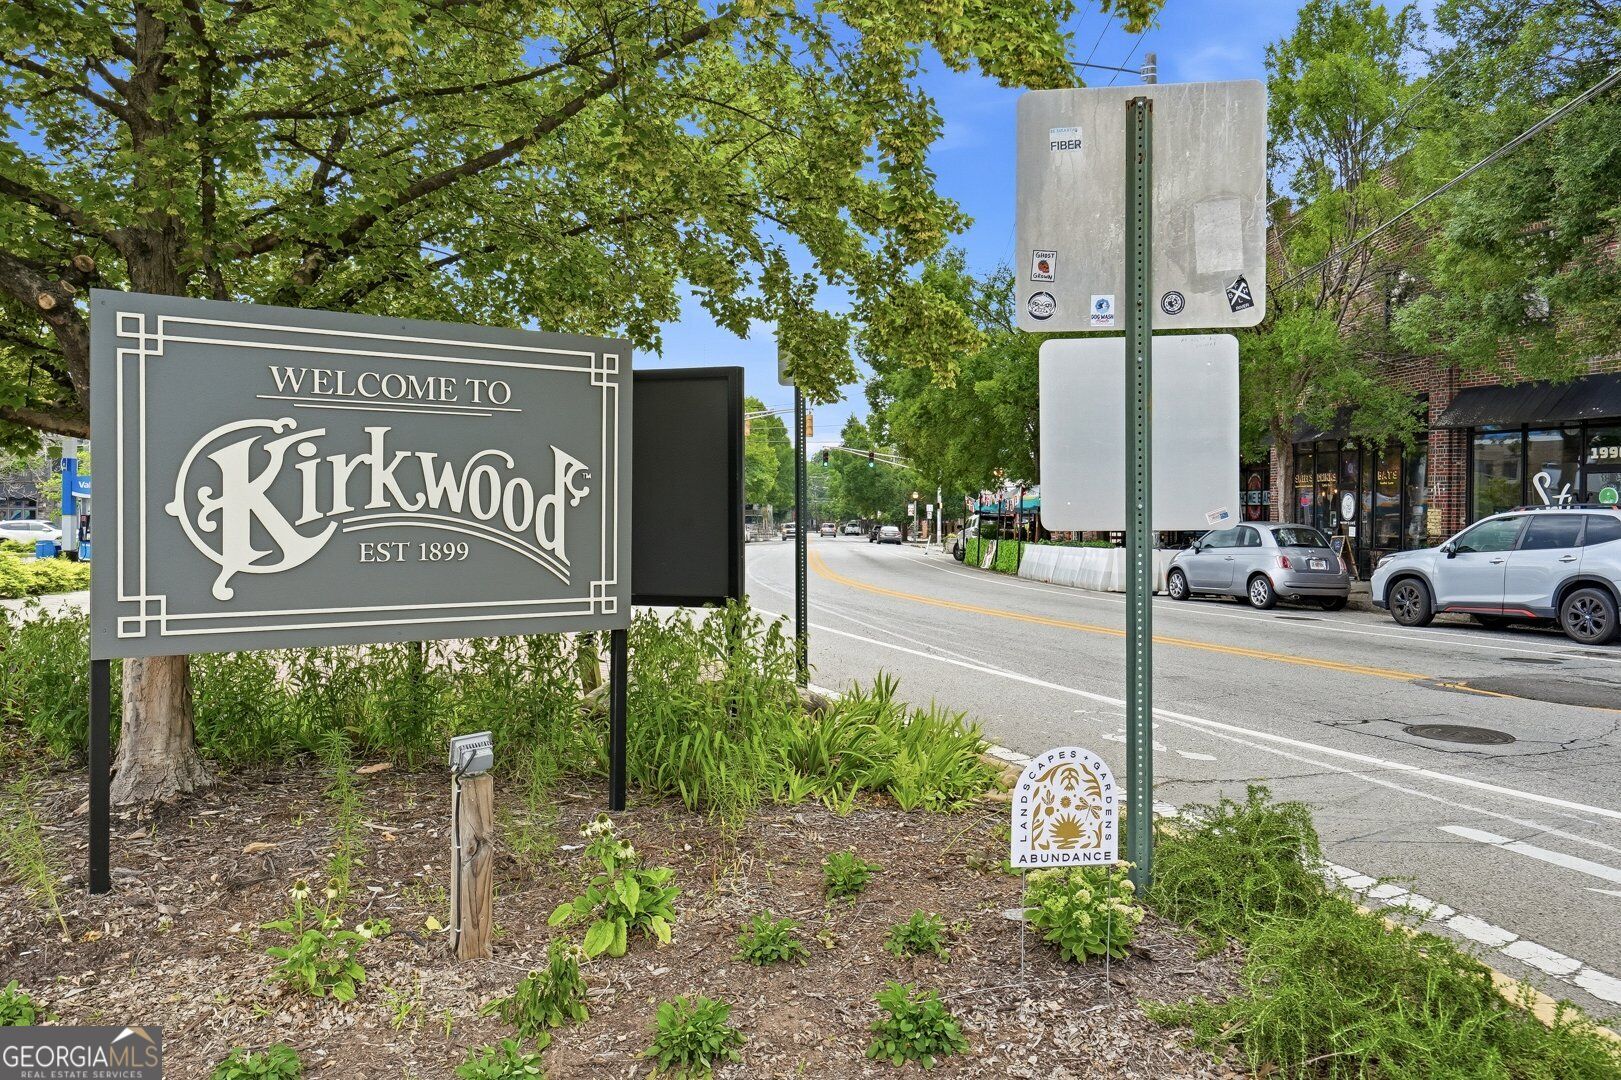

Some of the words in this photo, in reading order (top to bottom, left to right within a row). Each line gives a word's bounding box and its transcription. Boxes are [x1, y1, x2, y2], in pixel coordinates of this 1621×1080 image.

[1050, 140, 1082, 151] FIBER
[269, 365, 458, 402] WELCOME
[465, 378, 512, 405] TO
[1590, 446, 1621, 459] 199
[165, 417, 591, 601] Kirkwood
[359, 541, 410, 562] EST
[418, 541, 469, 561] 1899
[1019, 750, 1077, 843] LANDSCAPES
[1093, 761, 1112, 841] GARDENS
[1018, 851, 1112, 864] ABUNDANCE
